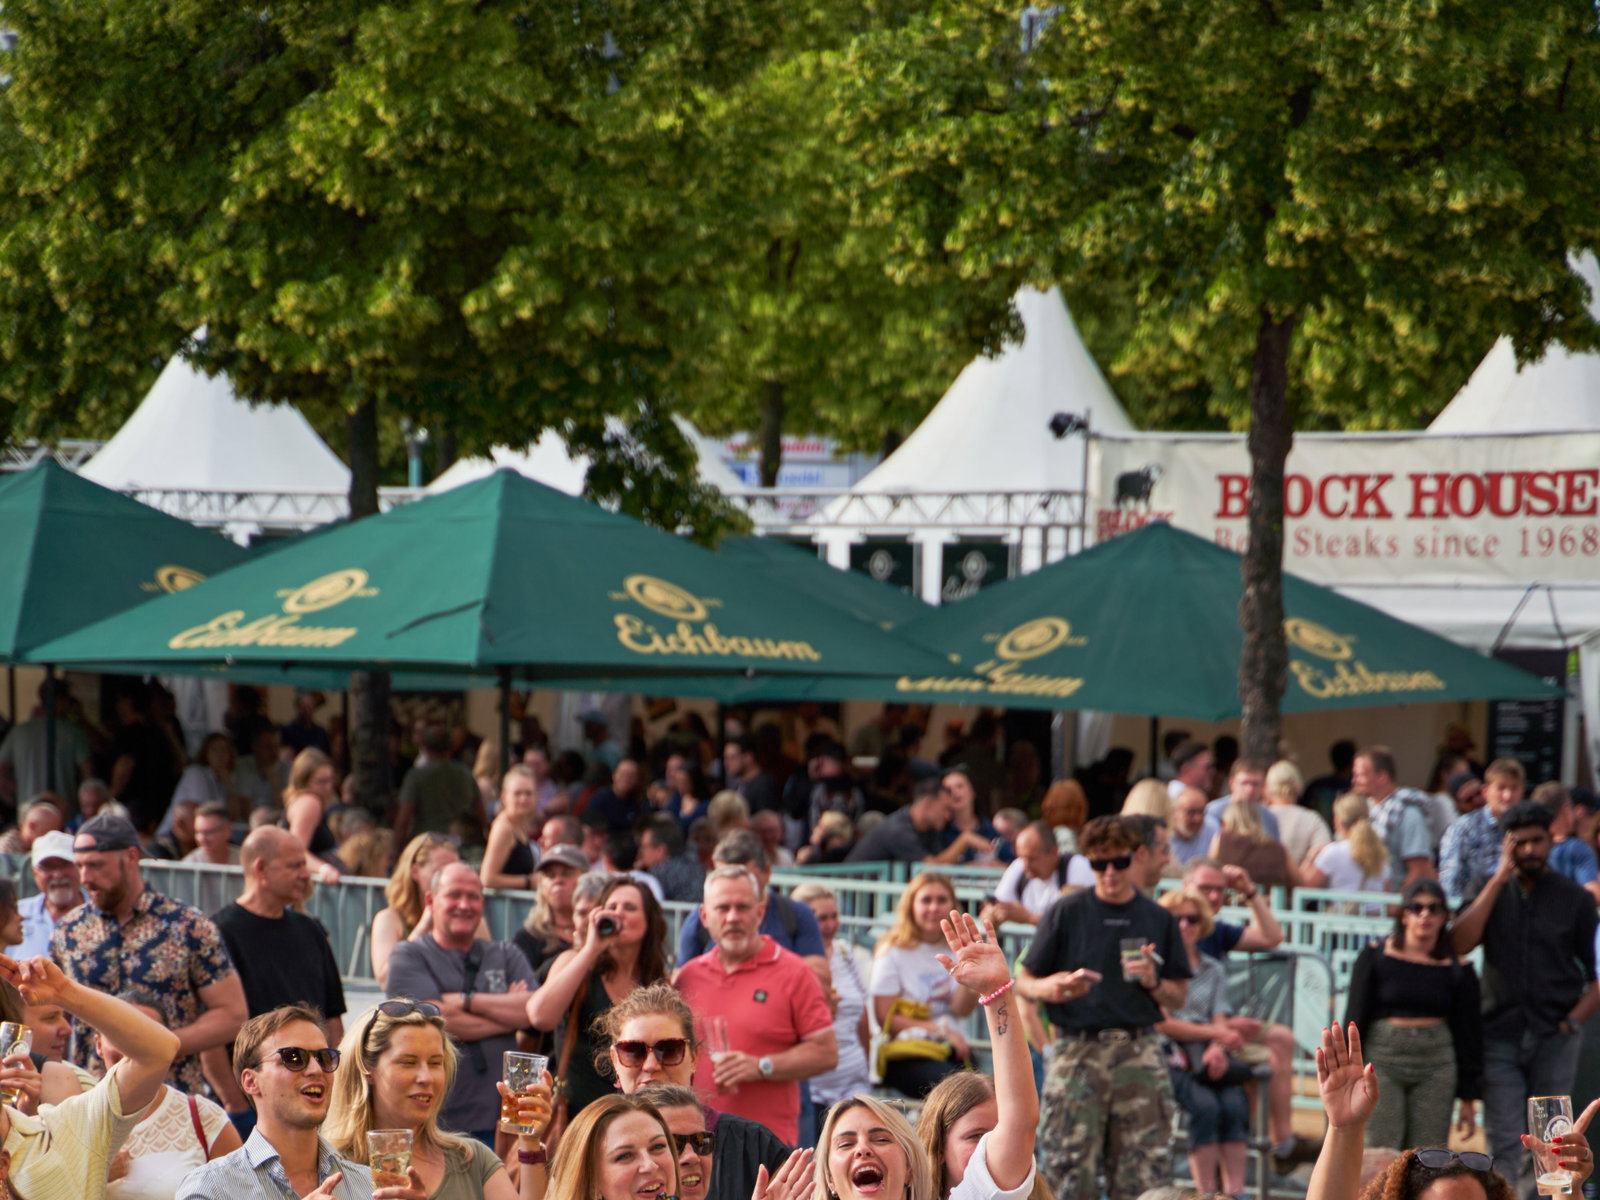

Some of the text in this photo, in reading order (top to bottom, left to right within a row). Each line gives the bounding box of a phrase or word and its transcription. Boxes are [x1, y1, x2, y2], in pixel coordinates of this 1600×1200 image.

[1214, 469, 1599, 519] BOCK HOUSE
[1097, 509, 1174, 536] BLOC
[1294, 526, 1400, 557] Steaks
[1413, 526, 1500, 557] since
[1519, 525, 1599, 557] 1968
[614, 613, 822, 662] Eichbaum
